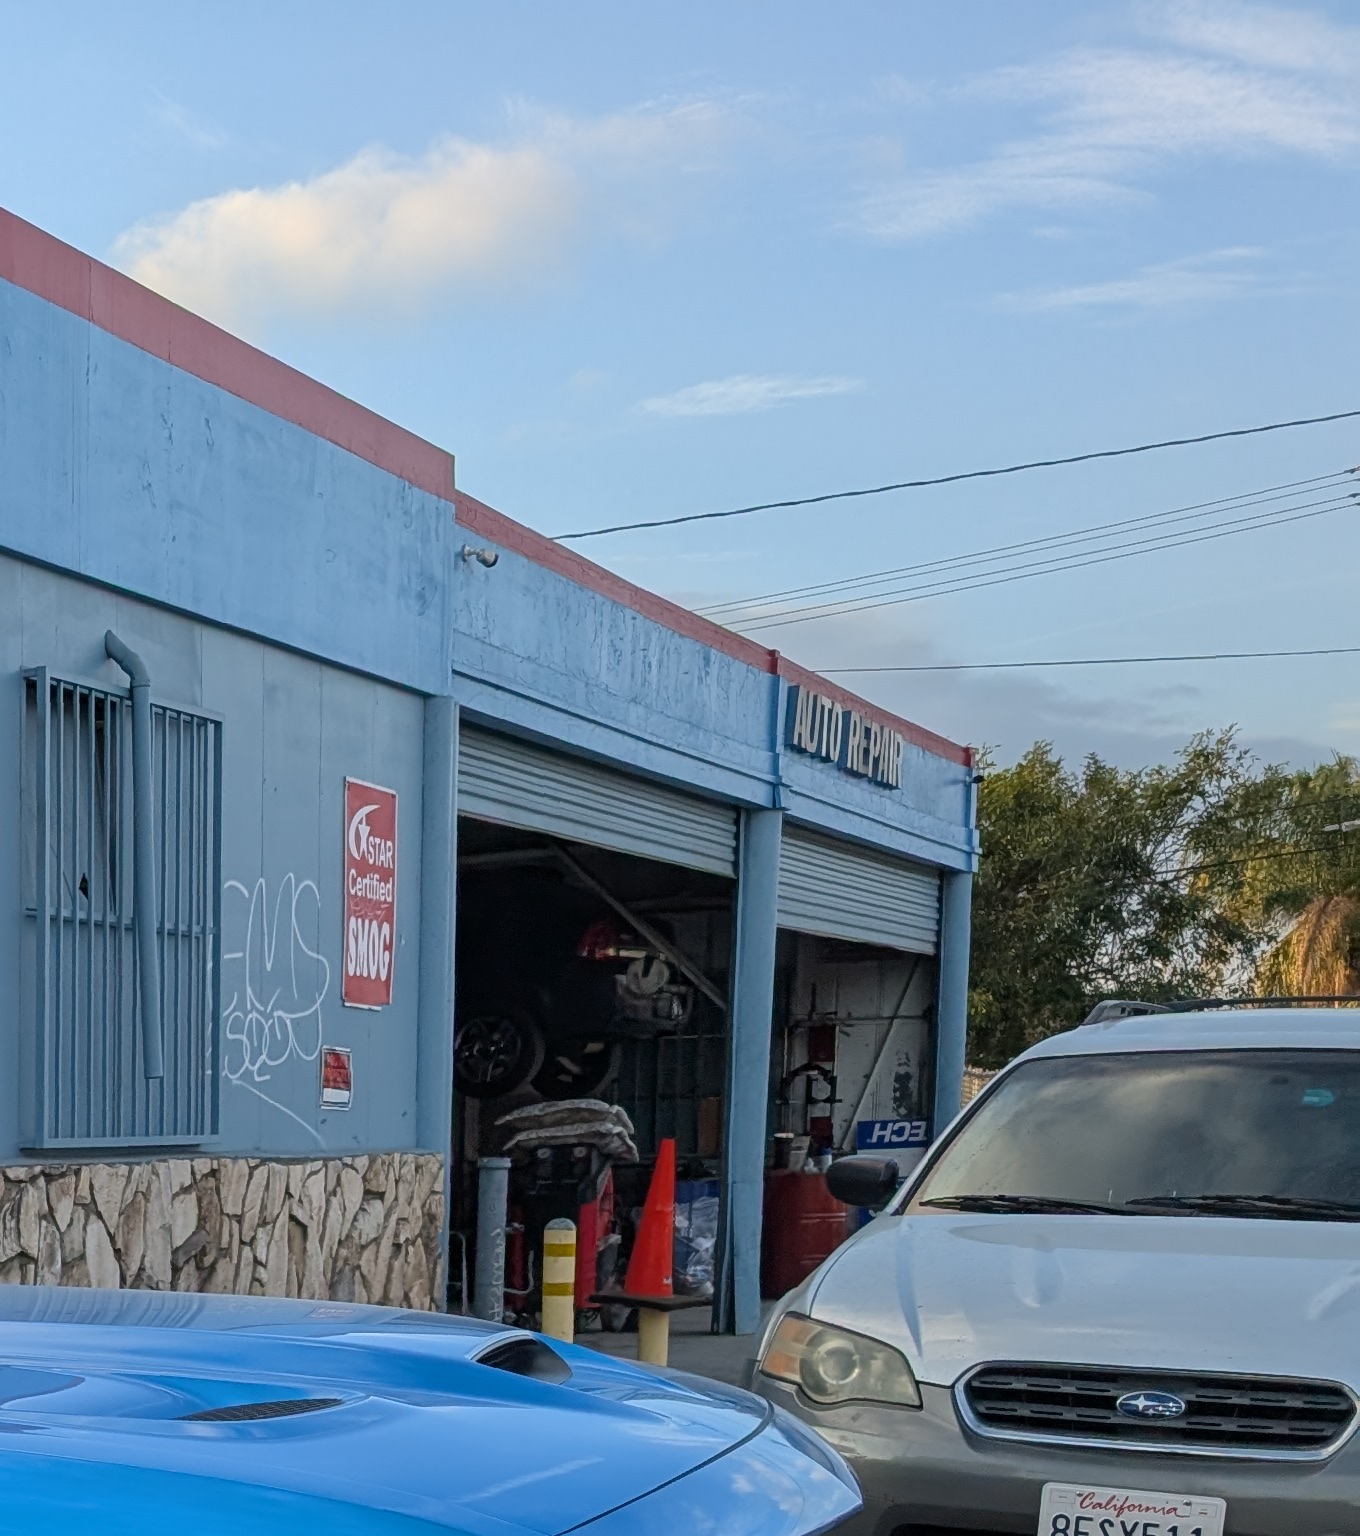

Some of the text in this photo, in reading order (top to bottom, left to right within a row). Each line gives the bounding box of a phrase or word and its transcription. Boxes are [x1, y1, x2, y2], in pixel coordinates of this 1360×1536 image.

[791, 685, 904, 789] AUTO REPAIR
[367, 836, 394, 869] STAR
[349, 868, 393, 903] Certified
[347, 916, 390, 982] SMOG
[1079, 1491, 1191, 1518] California
